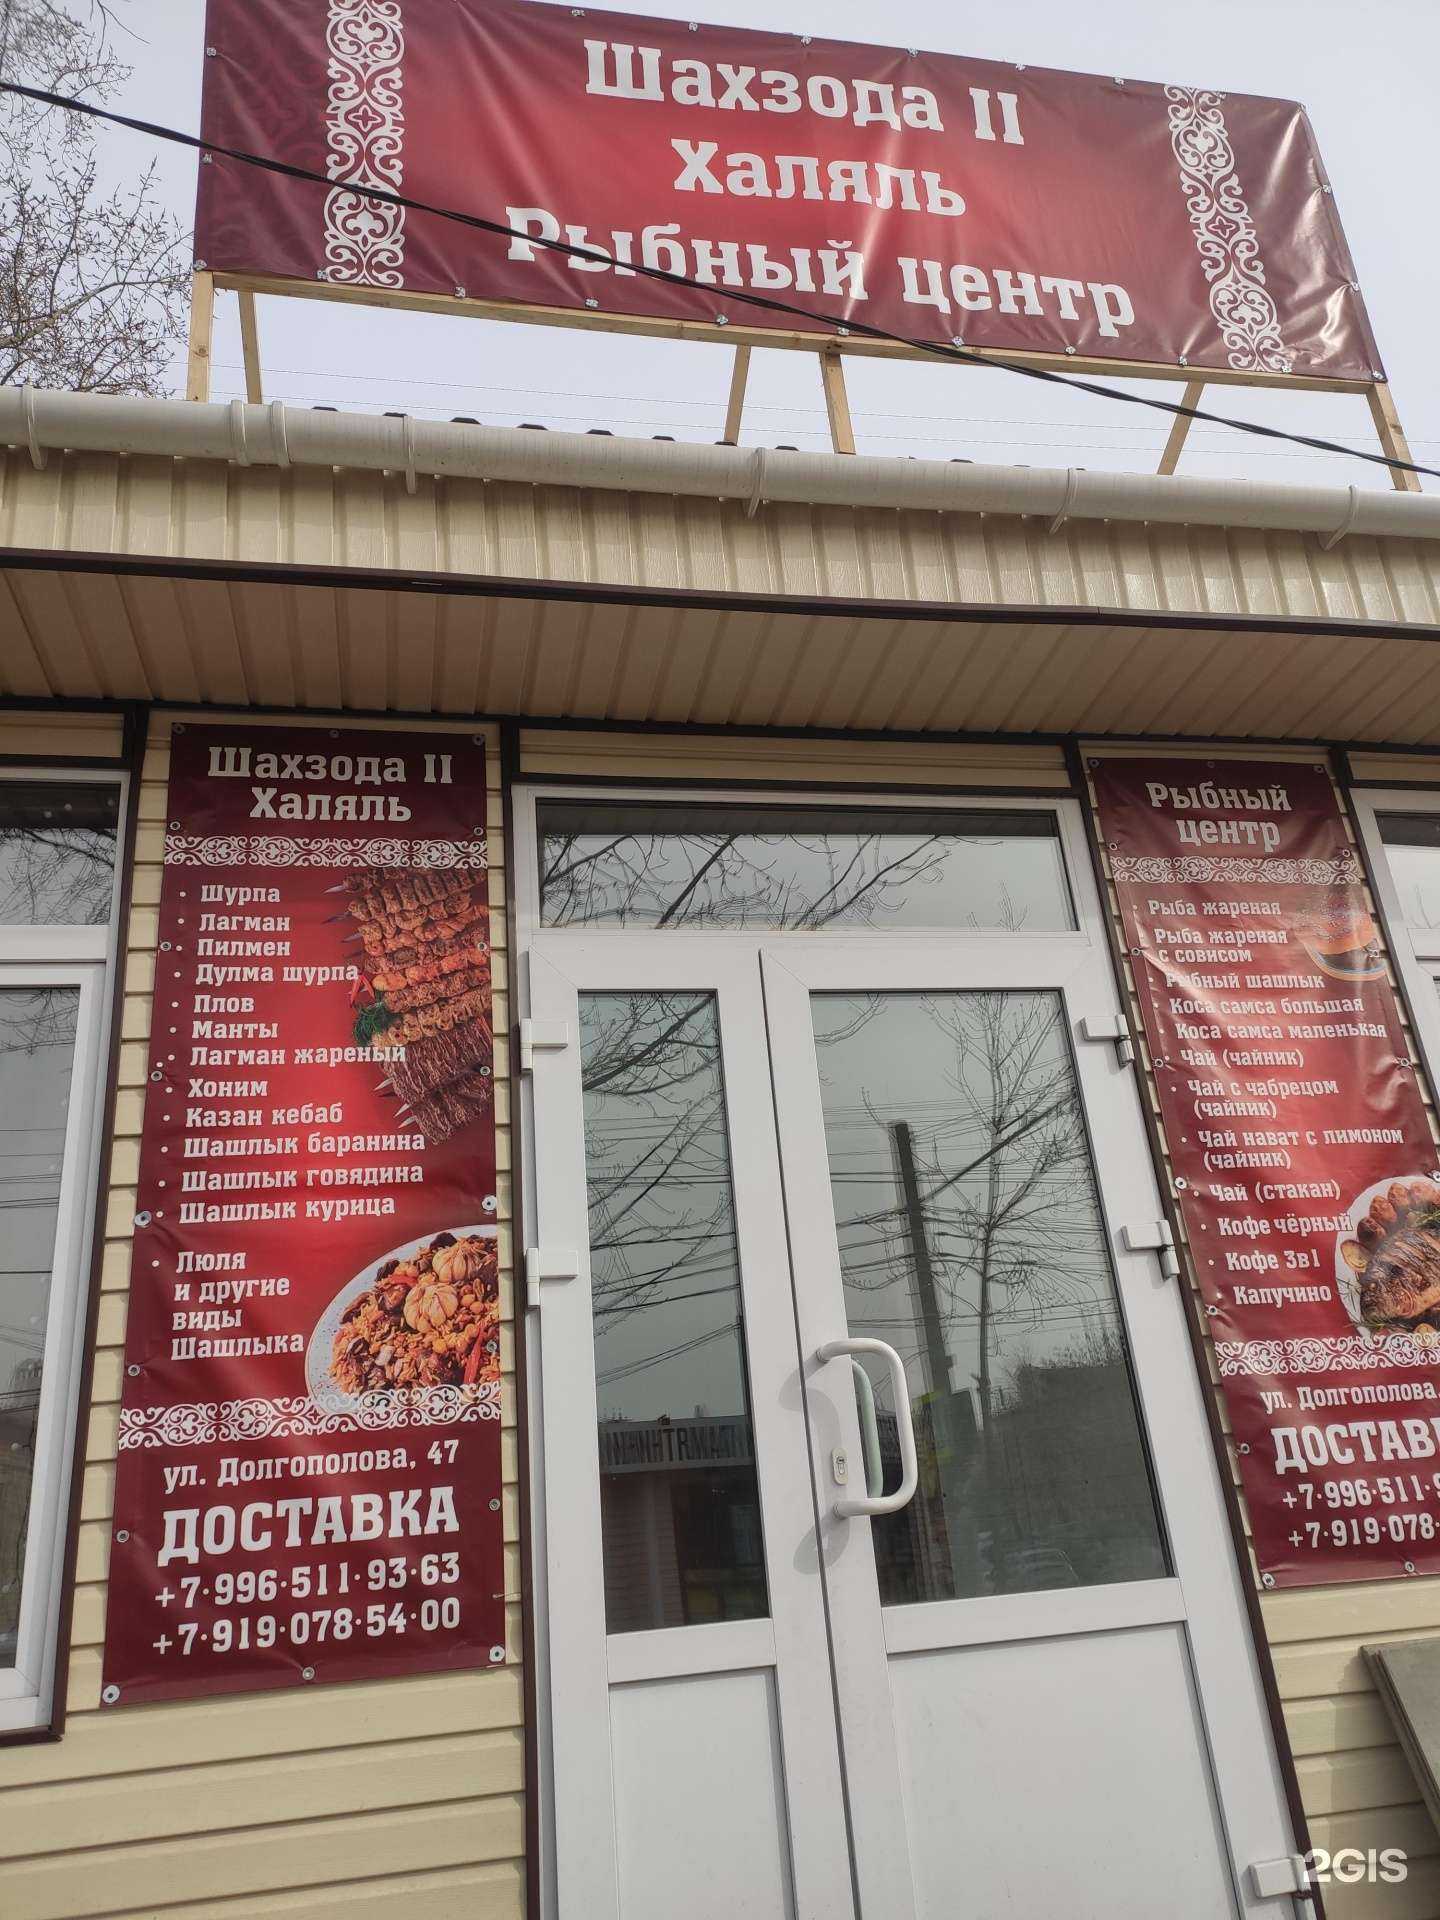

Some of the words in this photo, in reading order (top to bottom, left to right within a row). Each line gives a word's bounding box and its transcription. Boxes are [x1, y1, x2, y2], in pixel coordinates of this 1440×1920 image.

[584, 38, 944, 133] Шахзода
[671, 137, 966, 217] Халяль
[506, 205, 868, 301] Рыбный
[898, 256, 1135, 338] центр
[208, 746, 407, 785] Шахзода
[250, 786, 412, 822] Халяль
[1145, 781, 1292, 812] Рыбный
[1175, 818, 1281, 853] центр
[200, 884, 281, 906] Шурпа
[1147, 899, 1196, 916] Рыба
[1202, 900, 1282, 919] жареная
[199, 913, 290, 932] Лагман
[197, 938, 291, 957] Пилмен
[1154, 928, 1203, 945] Рыба
[1208, 928, 1289, 948] жареная
[1158, 950, 1169, 963] с
[1175, 948, 1253, 964] совисом
[195, 963, 274, 986] Дулма
[282, 964, 359, 986] шурпа
[1245, 974, 1326, 990] шашлык
[193, 994, 255, 1014] Плов
[1169, 998, 1217, 1015] Коса
[1219, 999, 1277, 1015] самса
[1281, 996, 1365, 1015] большая
[191, 1020, 278, 1039] Манты
[1175, 1023, 1221, 1040] Коса
[1227, 1024, 1284, 1040] самса
[1289, 1023, 1388, 1039] маленькая
[189, 1046, 286, 1067] Лагман
[294, 1045, 406, 1068] жареный
[1180, 1048, 1217, 1067] Чай
[1222, 1048, 1304, 1069] (чайник)
[187, 1078, 268, 1098] Хоним
[1187, 1078, 1225, 1097] Чай
[1230, 1082, 1240, 1096] с
[1246, 1078, 1339, 1100] чабрецом
[185, 1107, 263, 1128] Казан
[272, 1102, 343, 1126] кебаб
[1194, 1099, 1277, 1121] (чайник)
[183, 1136, 298, 1158] Шашлык
[307, 1131, 426, 1157] баранина
[1198, 1130, 1238, 1148] Чай
[1242, 1130, 1299, 1147] нават
[1306, 1132, 1317, 1146] с
[1323, 1127, 1404, 1145] лимоном
[1203, 1149, 1292, 1173] (чайник)
[181, 1169, 298, 1192] Шашлык
[306, 1164, 424, 1188] говядина
[1208, 1183, 1249, 1203] Чай
[1255, 1179, 1341, 1203] (стакан)
[179, 1200, 296, 1225] Шашлык
[305, 1197, 396, 1222] курица
[1217, 1216, 1270, 1243] Кофе
[1273, 1212, 1353, 1236] чёрный
[176, 1250, 247, 1274] Люля
[1225, 1251, 1279, 1274] Кофе
[174, 1284, 190, 1302] и
[198, 1276, 290, 1305] другие
[1233, 1285, 1331, 1308] Капучино
[172, 1308, 242, 1332] виды
[171, 1335, 304, 1361] Шашлыка
[1260, 1390, 1292, 1414] ул.
[163, 1462, 207, 1495] ул.
[217, 1444, 416, 1489] Долгополова,
[427, 1438, 459, 1466] 47
[157, 1486, 460, 1568] ДОСТАВКА
